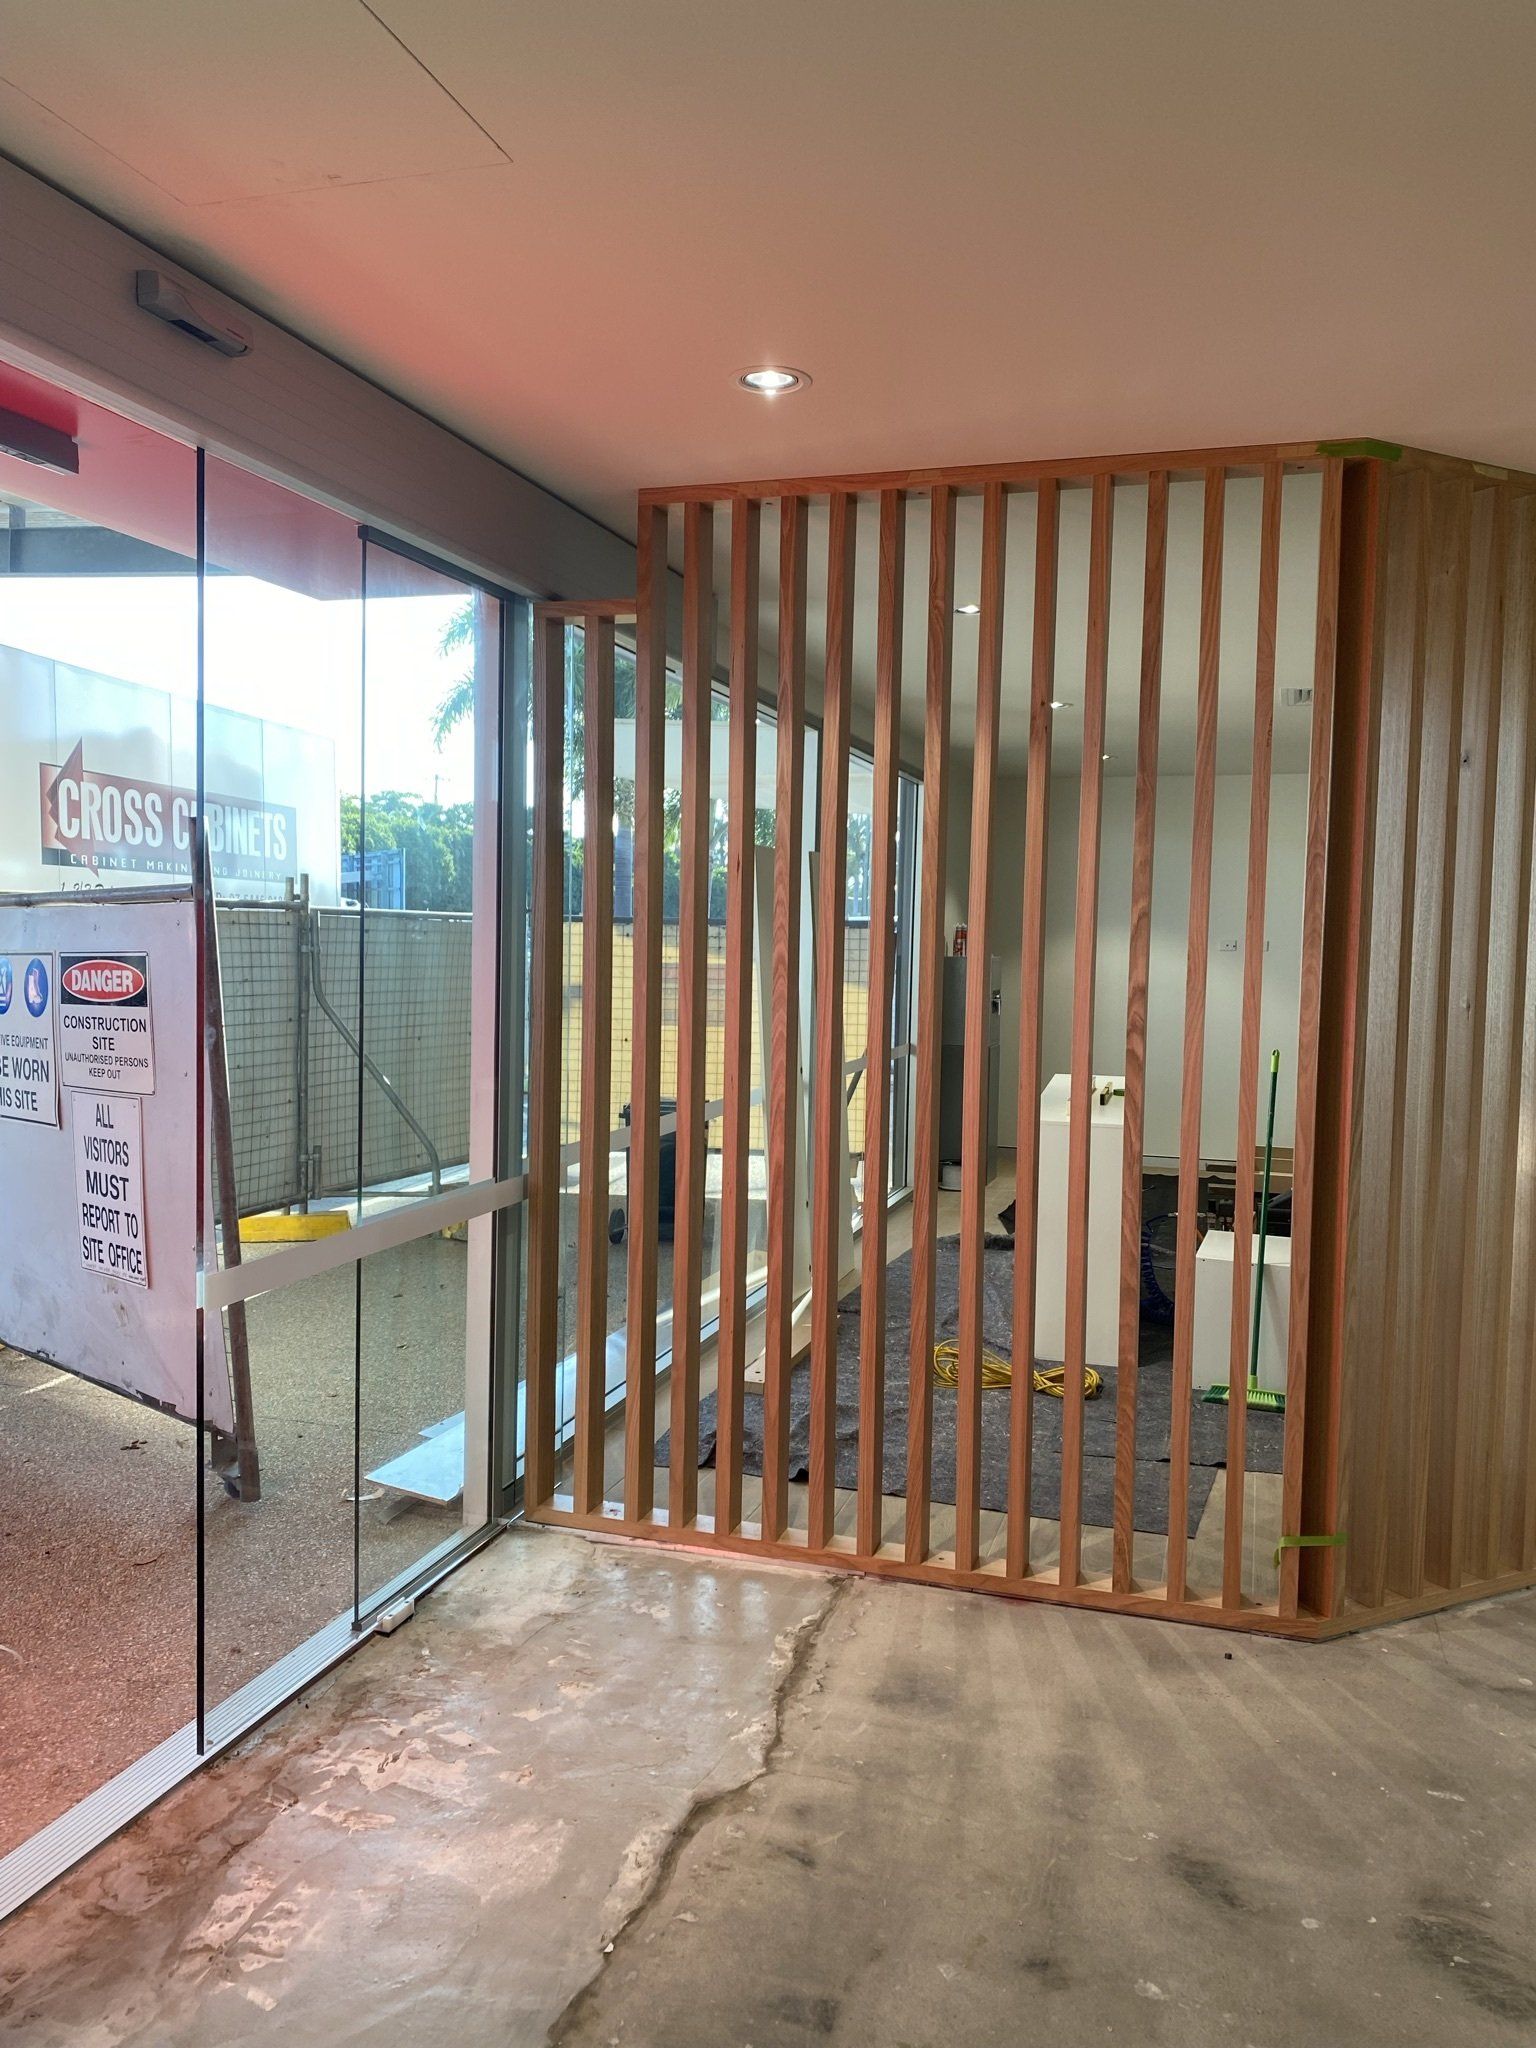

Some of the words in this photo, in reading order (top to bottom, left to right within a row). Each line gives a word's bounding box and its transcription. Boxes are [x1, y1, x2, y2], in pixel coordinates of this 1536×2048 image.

[58, 778, 164, 848] CROSS
[172, 797, 287, 861] CBINETS
[70, 853, 137, 869] CABINET
[146, 860, 188, 873] MAKIN
[71, 969, 134, 992] DANGER
[63, 1015, 147, 1033] CONSTRUCTION
[11, 1034, 48, 1050] EQUIPMENT
[92, 1036, 115, 1051] SITE
[11, 1056, 49, 1082] WORN
[64, 1052, 113, 1066] UNAUTHORISED
[114, 1056, 149, 1068] PERSONS
[88, 1067, 106, 1078] KEEP
[106, 1069, 121, 1079] OUT
[14, 1088, 38, 1112] SITE
[95, 1103, 114, 1129] ALL
[83, 1135, 130, 1167] VISITORS
[85, 1169, 130, 1202] MUST
[82, 1202, 120, 1235] REPORT
[124, 1212, 139, 1239] TO
[82, 1235, 105, 1264] SITE
[108, 1242, 143, 1275] OFFICE
